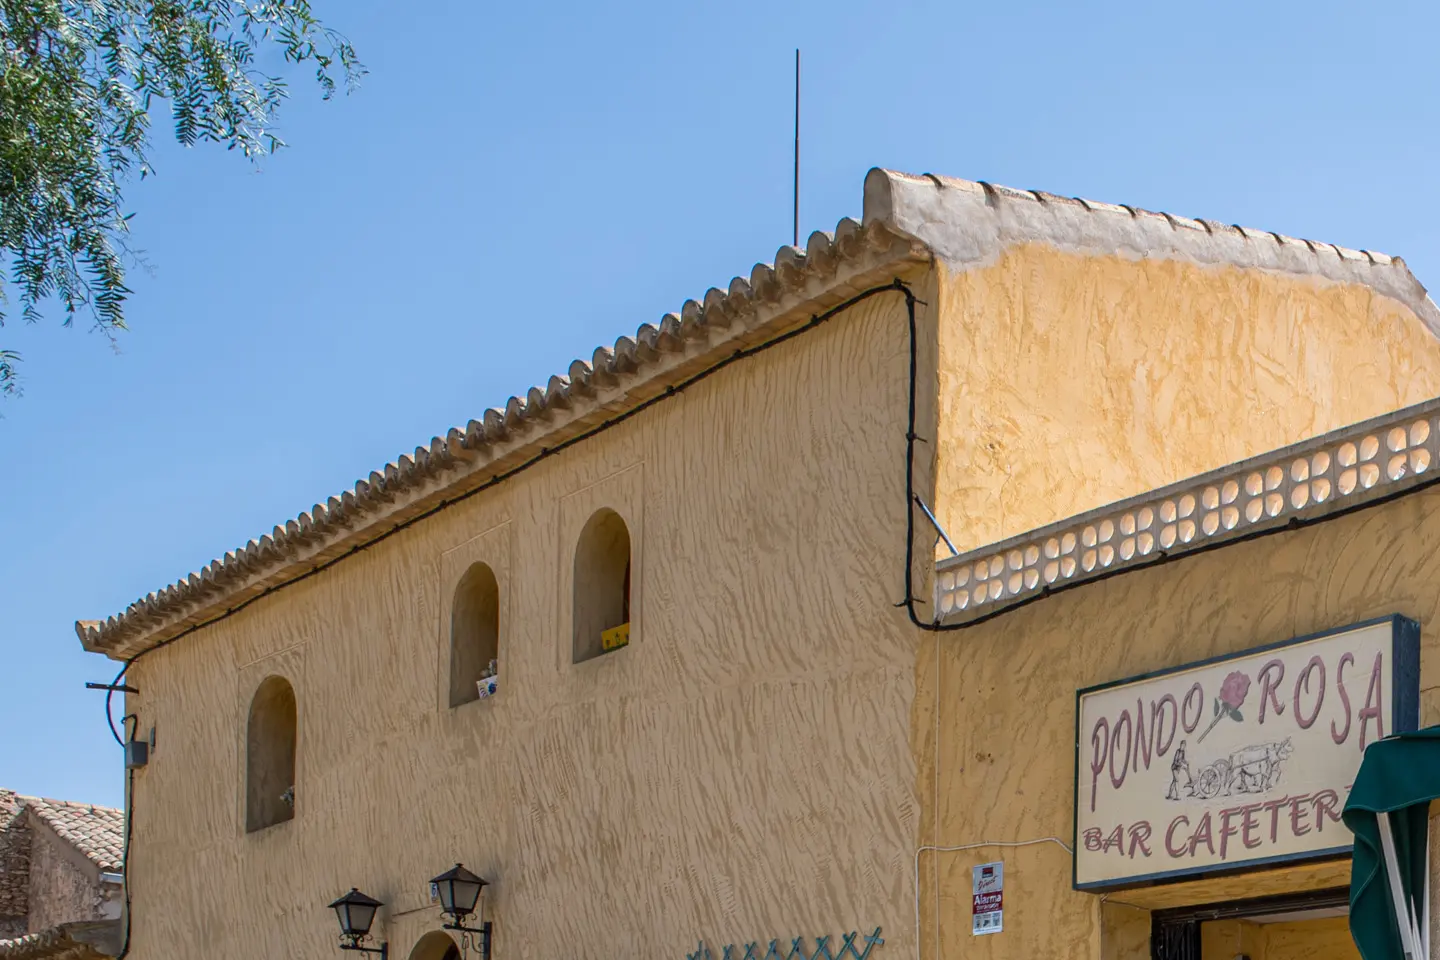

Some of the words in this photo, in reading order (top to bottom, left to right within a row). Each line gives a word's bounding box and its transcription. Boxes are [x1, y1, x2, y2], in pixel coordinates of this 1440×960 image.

[1091, 682, 1204, 812] PONDO
[1257, 649, 1384, 751] ROSA
[1083, 820, 1153, 860] BAR
[1164, 785, 1353, 860] CAFETER
[974, 894, 1002, 906] Alarma
